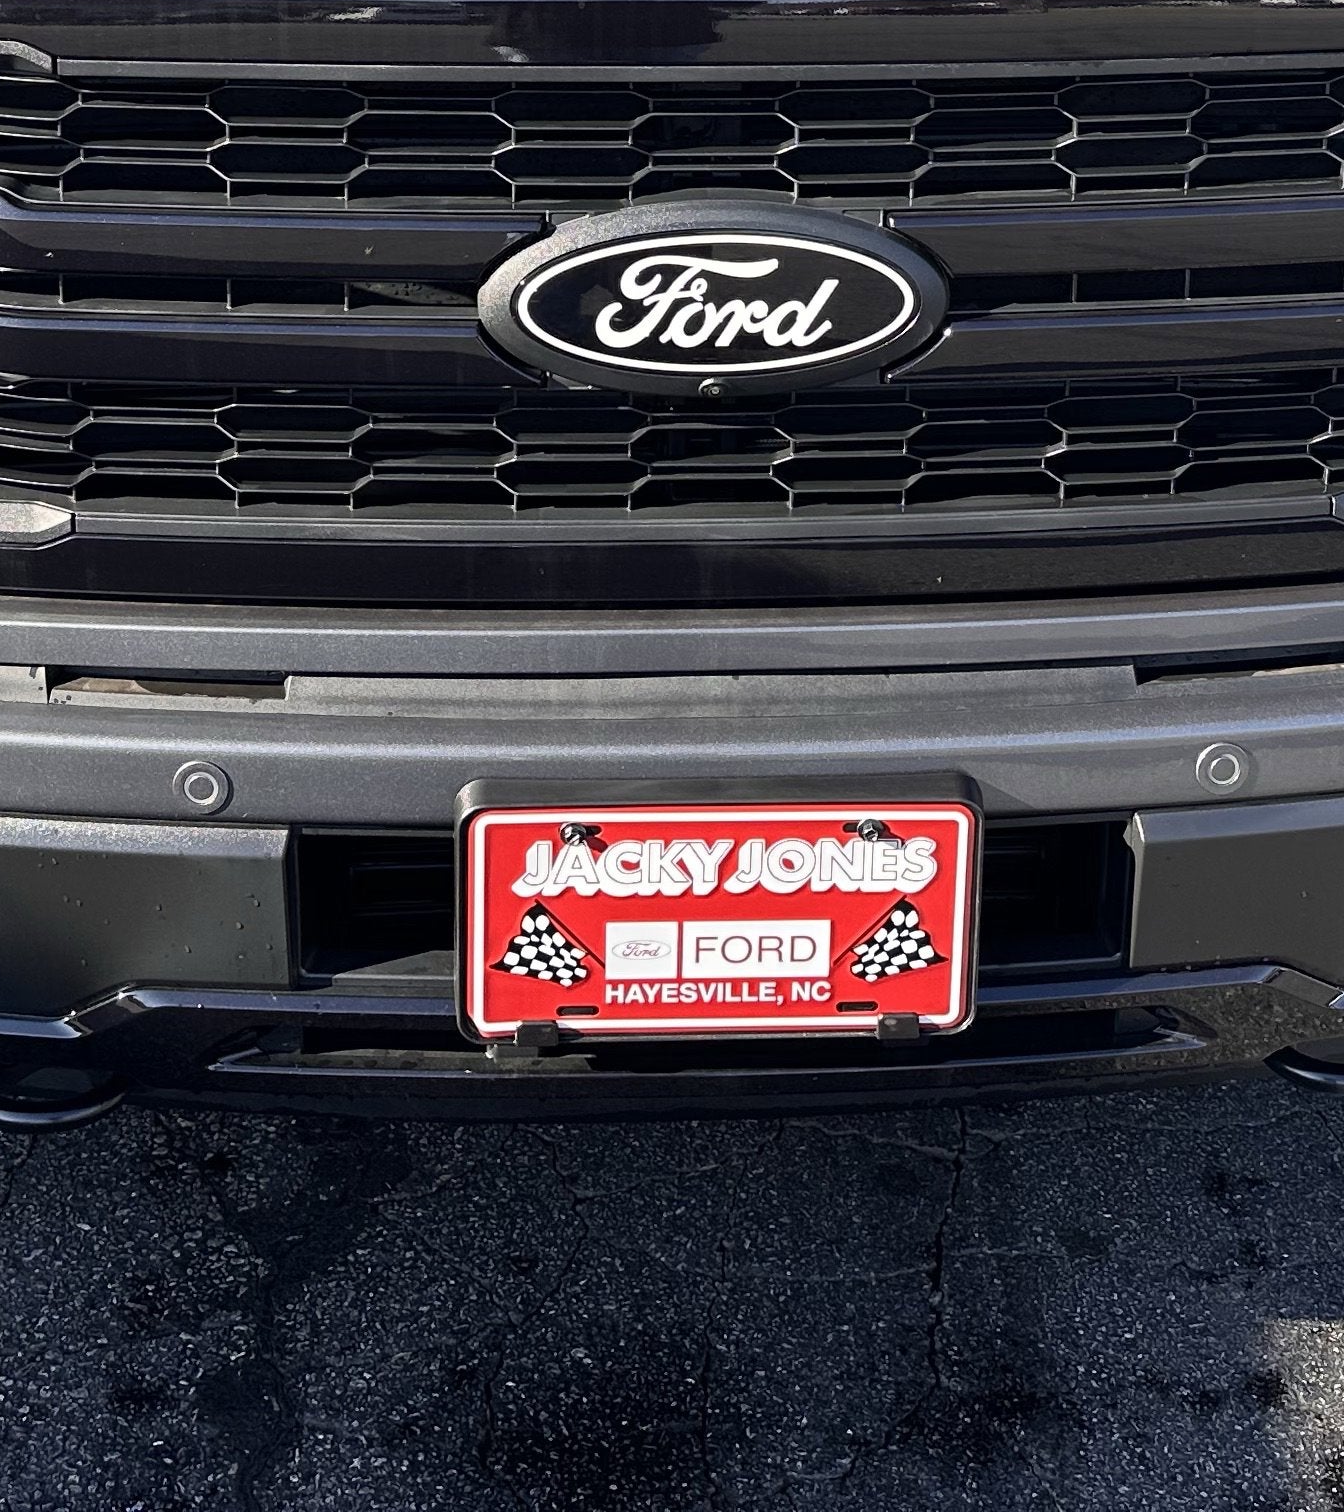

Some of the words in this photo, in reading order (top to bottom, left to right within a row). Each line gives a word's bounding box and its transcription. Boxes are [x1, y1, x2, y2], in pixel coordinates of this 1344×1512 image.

[595, 255, 840, 349] Ford
[511, 838, 734, 899] JACKY
[723, 837, 939, 895] JONES
[622, 942, 661, 957] Ford
[695, 935, 818, 965] FORD
[605, 983, 784, 1006] HAYESVILLE,
[789, 981, 832, 1002] NC
